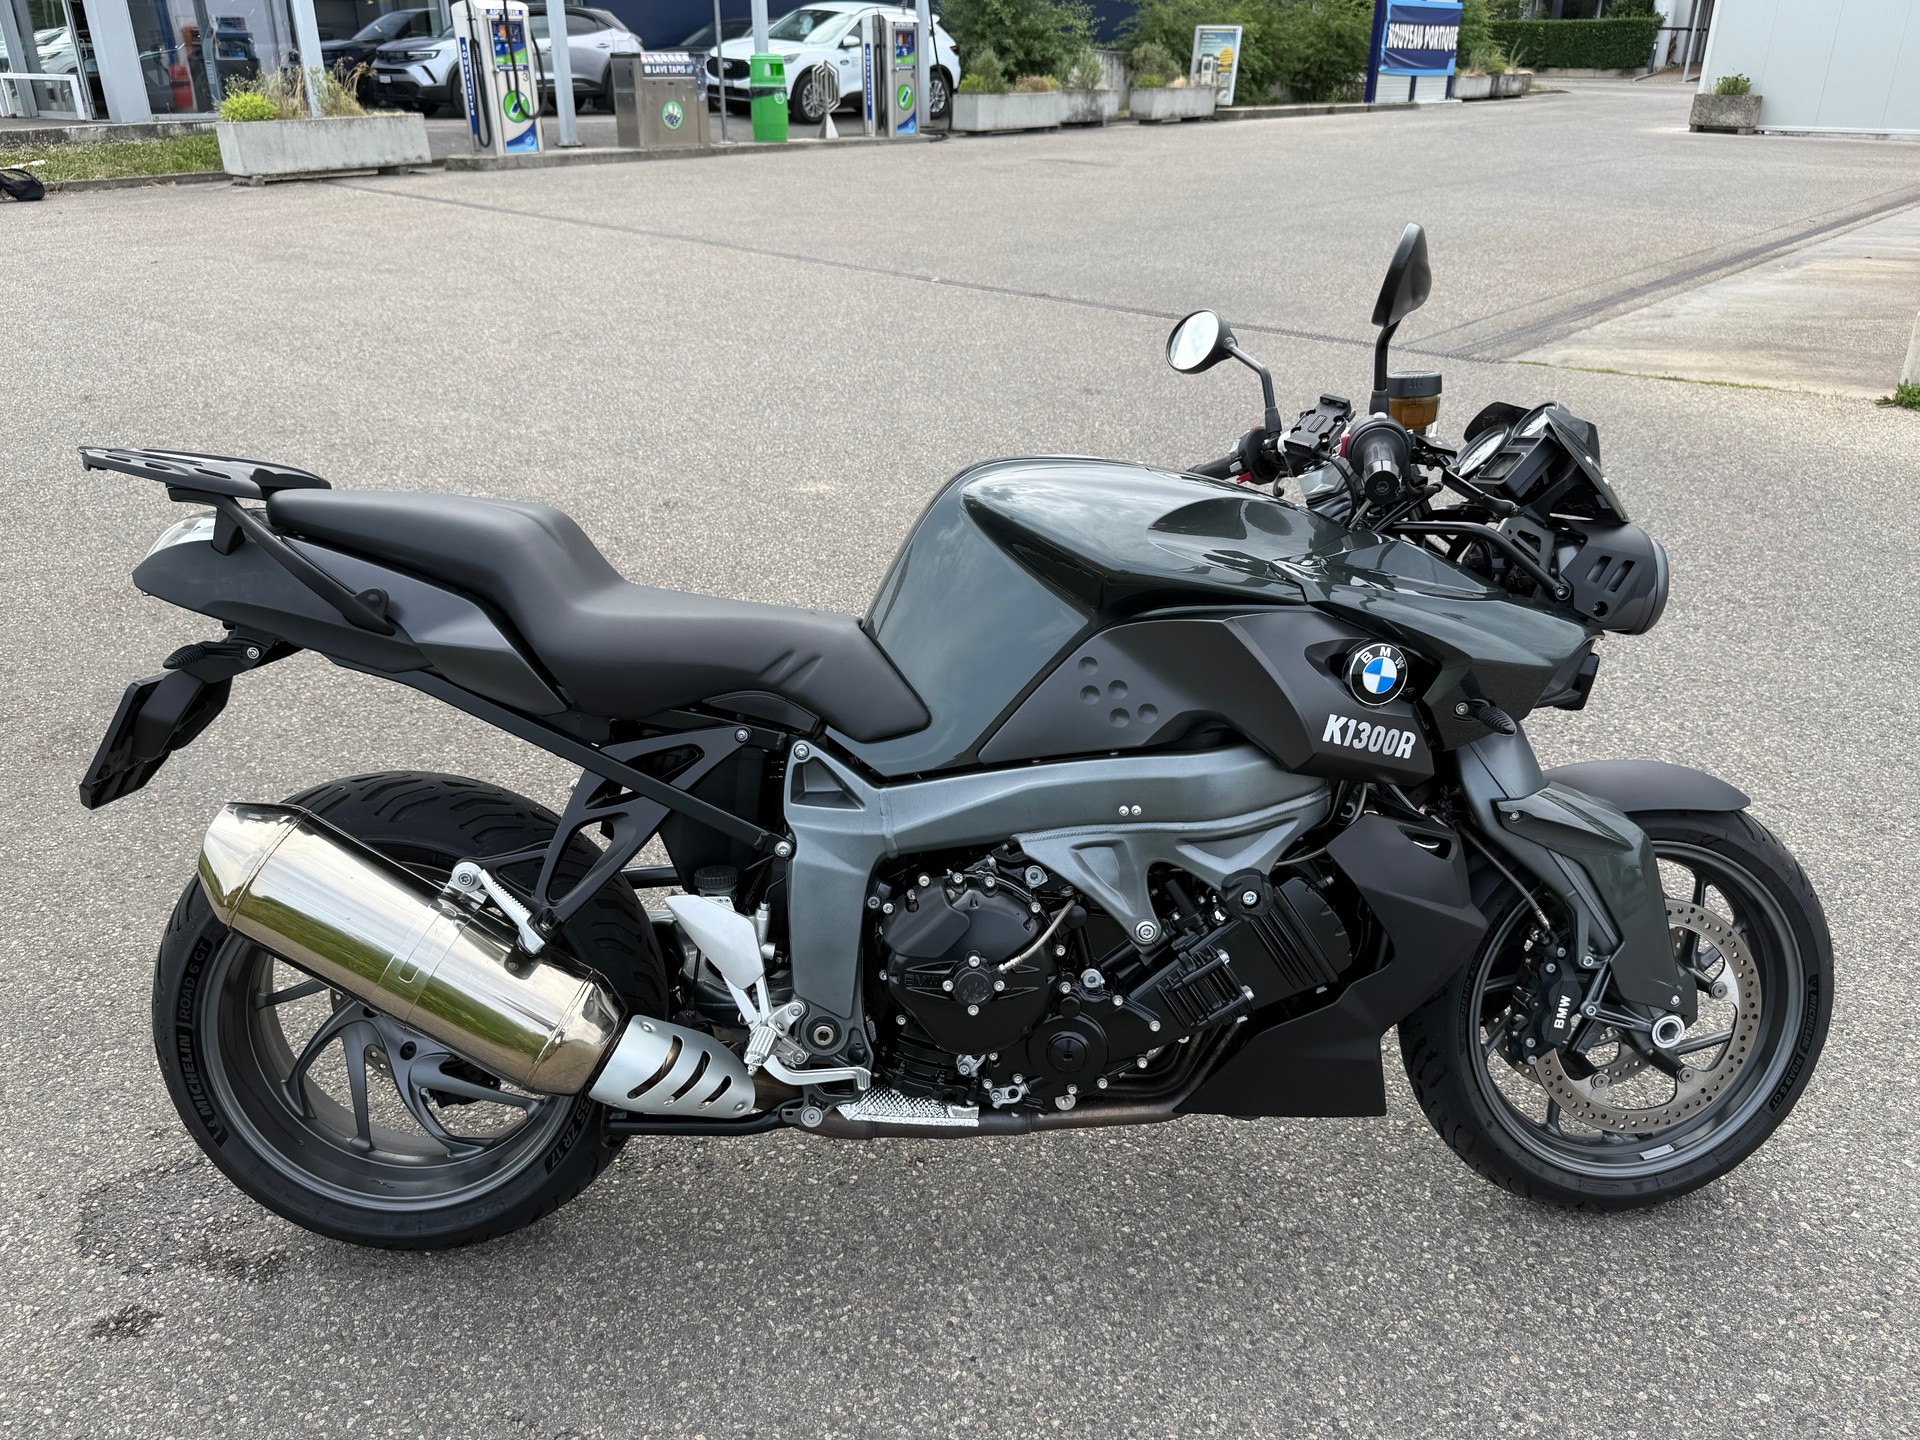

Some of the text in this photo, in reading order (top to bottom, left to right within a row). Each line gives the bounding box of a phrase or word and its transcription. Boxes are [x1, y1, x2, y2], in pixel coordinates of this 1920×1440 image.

[1386, 23, 1459, 52] NOUVEAU PORTIQUE
[652, 65, 686, 74] LAVE TAPIS
[1360, 646, 1406, 670] BMW
[1322, 713, 1417, 760] K1300R
[1553, 995, 1571, 1029] BMW
[1802, 994, 1818, 1050] MICHELIN
[179, 941, 213, 1116] MICHELIN ROAD 6 GT
[562, 1122, 578, 1149] ZR
[551, 1148, 564, 1168] 17
